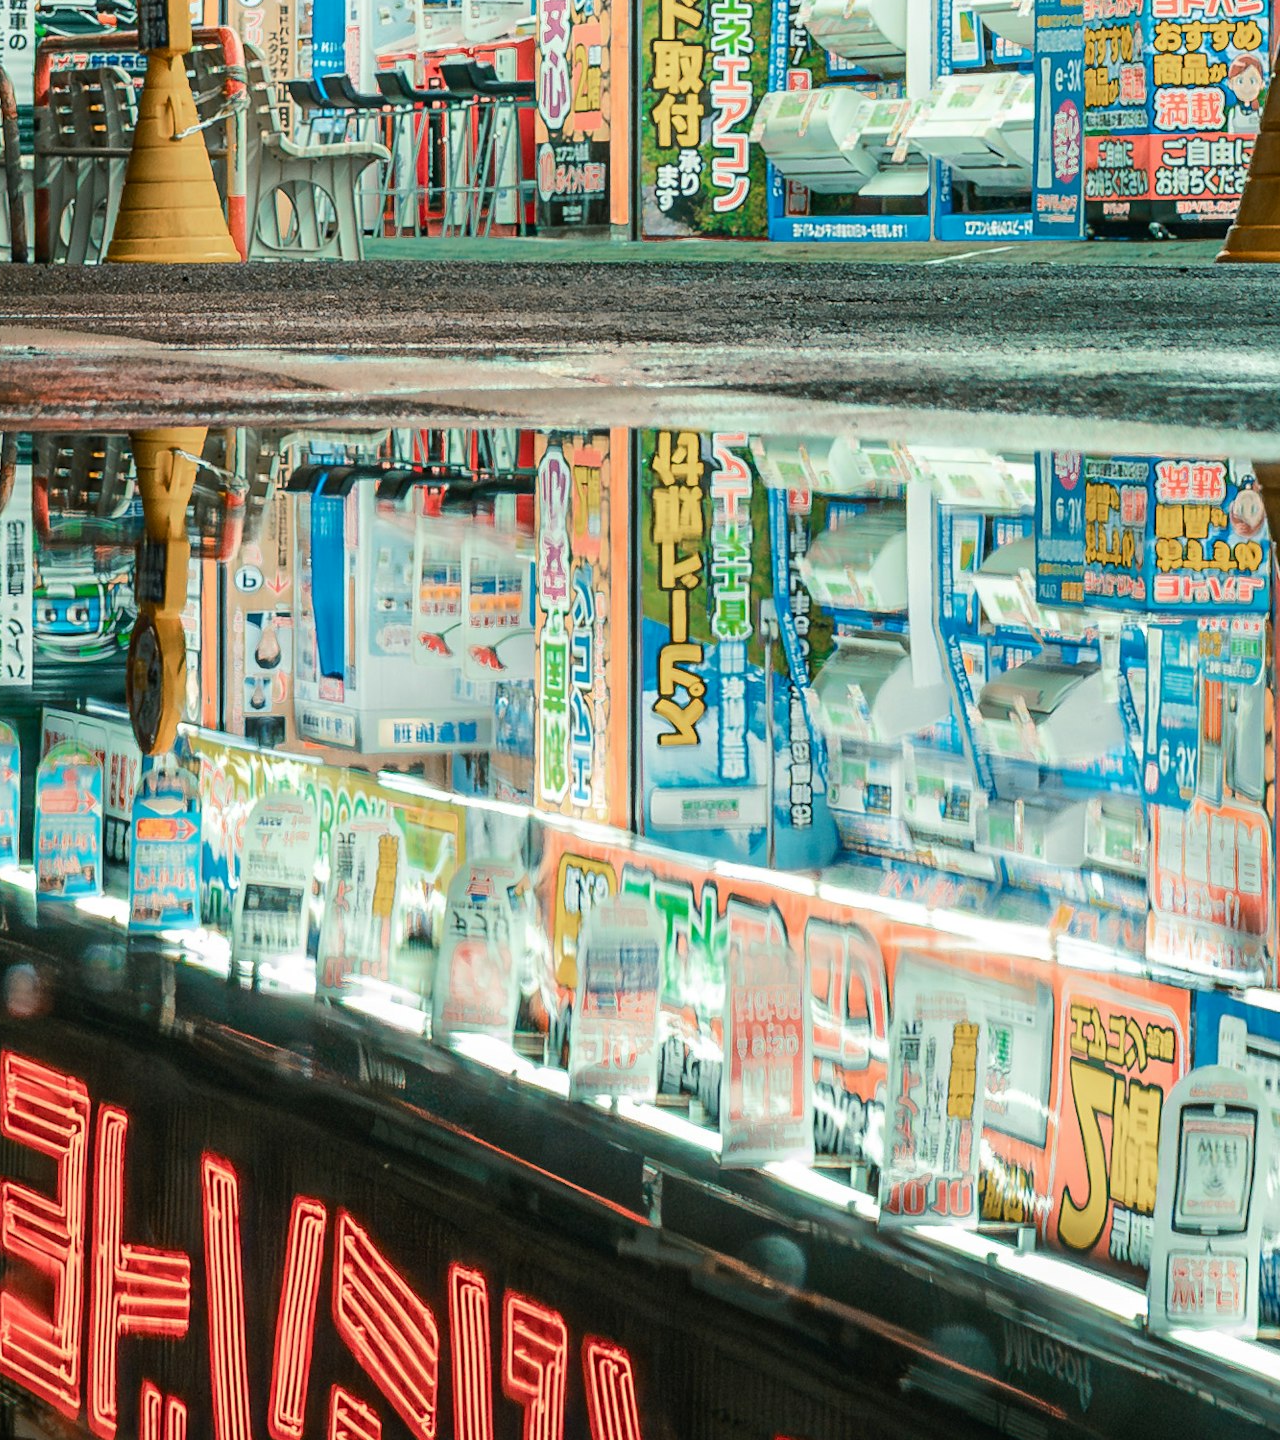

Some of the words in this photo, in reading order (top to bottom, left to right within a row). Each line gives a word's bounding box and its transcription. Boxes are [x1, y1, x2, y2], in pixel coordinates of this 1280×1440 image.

[277, 4, 292, 80] ヨドバシカメラ
[1083, 25, 1134, 66] おすすめ
[1152, 20, 1263, 53] おすすめ
[1054, 58, 1082, 93] e-3X
[1083, 65, 1120, 108] 商品が
[1119, 61, 1148, 106] 満載
[1153, 52, 1228, 86] 商品が
[1153, 86, 1226, 131] 満載
[1096, 138, 1135, 167] ご自由に
[1161, 137, 1258, 168] ご自由に
[654, 161, 676, 214] ます
[677, 147, 700, 197] 承り
[1085, 167, 1149, 198] お持ちください
